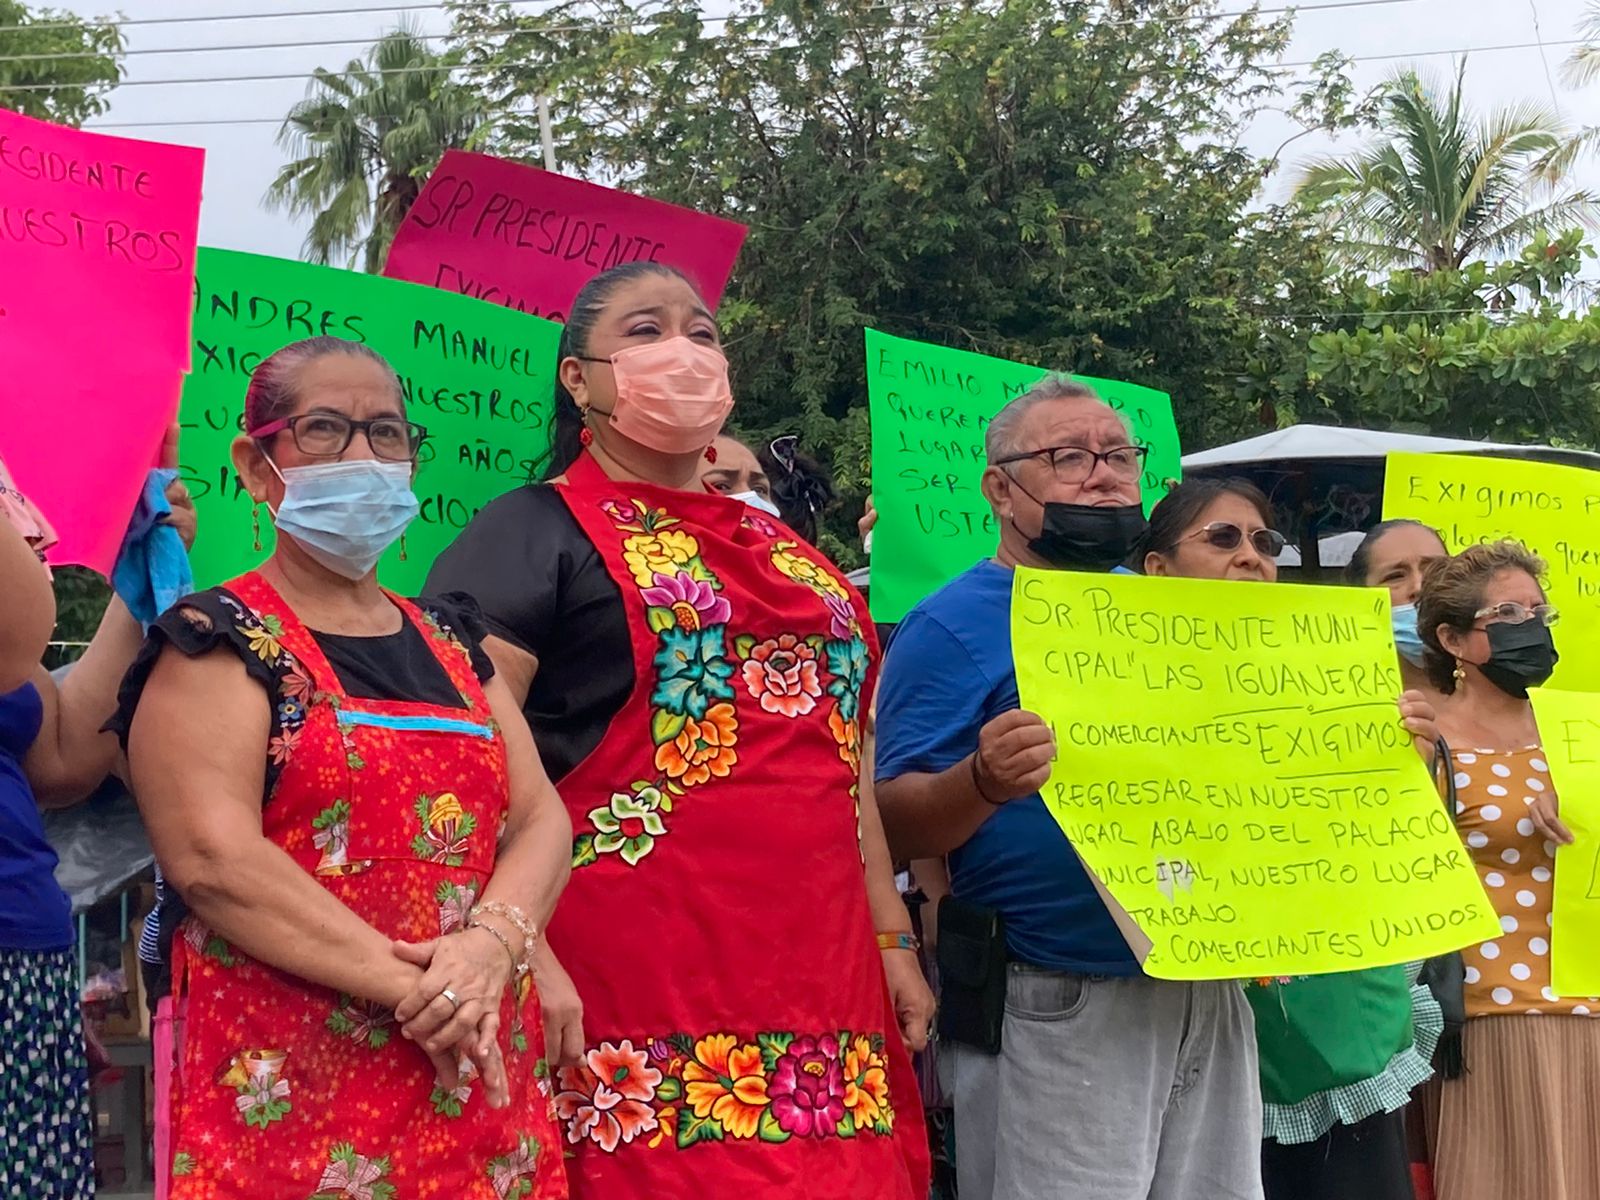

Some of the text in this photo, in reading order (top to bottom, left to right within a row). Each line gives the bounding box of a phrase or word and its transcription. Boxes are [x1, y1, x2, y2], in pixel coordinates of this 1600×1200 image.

[0, 207, 184, 272] UESTROS
[411, 175, 666, 270] SR PRESIDENTE
[413, 319, 538, 377] MANUEL
[878, 348, 982, 396] EMILIO
[898, 468, 970, 494] SER
[1083, 586, 1281, 651] PRESIDENTE
[1142, 663, 1203, 691] LAS
[1224, 662, 1401, 701] IGUANERAS
[1069, 721, 1251, 747] COMERCIANTES
[1255, 718, 1412, 765] EXIGIMOS
[1054, 779, 1202, 813] REGRESAR
[1206, 783, 1243, 809] EN
[1249, 783, 1390, 811] NUESTRO
[1068, 809, 1450, 850] UGAR ABAJO DEL PALACIO
[1230, 859, 1359, 887] NUESTRO
[1374, 850, 1467, 882] LUGAR
[1170, 931, 1363, 964] COMERCIANTES
